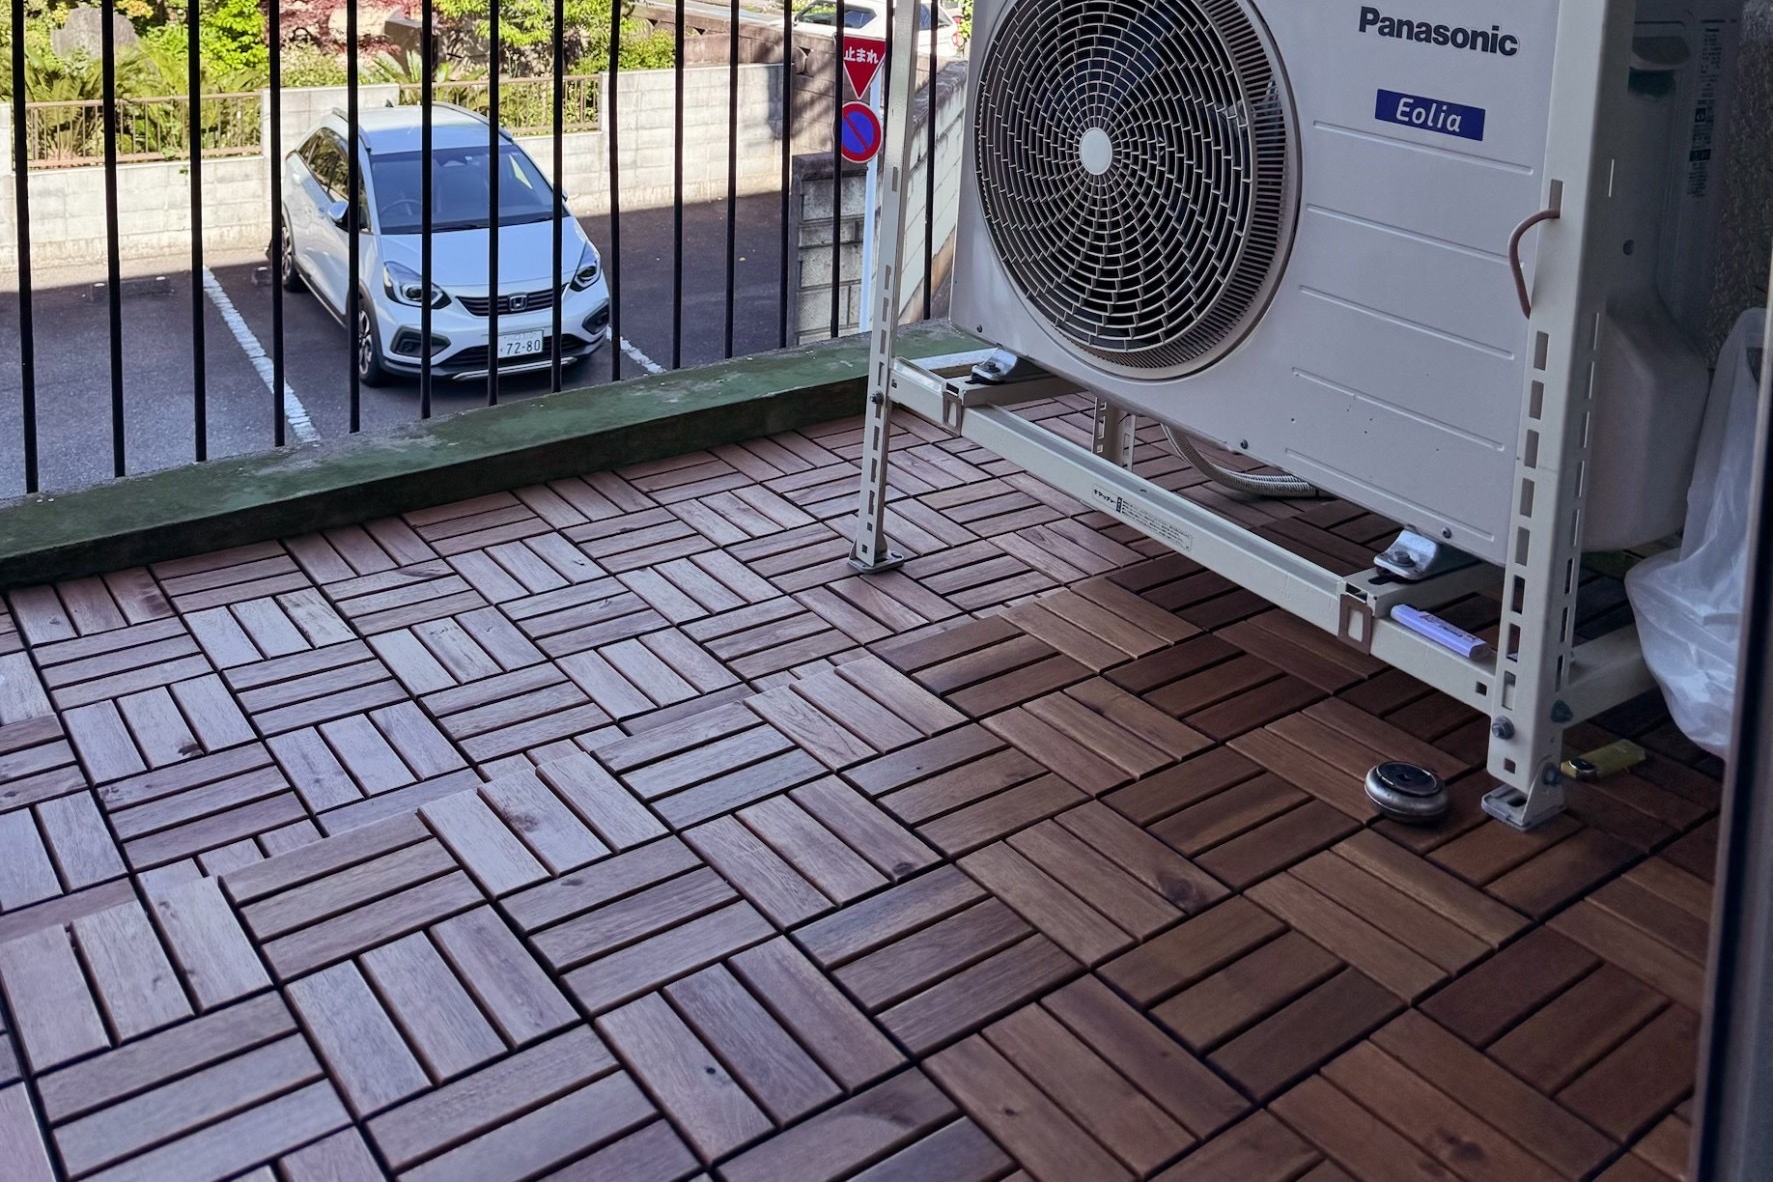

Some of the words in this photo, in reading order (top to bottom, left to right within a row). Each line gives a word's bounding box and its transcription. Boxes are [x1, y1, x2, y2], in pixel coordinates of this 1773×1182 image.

[1358, 5, 1519, 57] Panasonic
[843, 46, 879, 64] 止まれ
[1395, 97, 1463, 133] Eolia
[506, 339, 541, 355] 72-80
